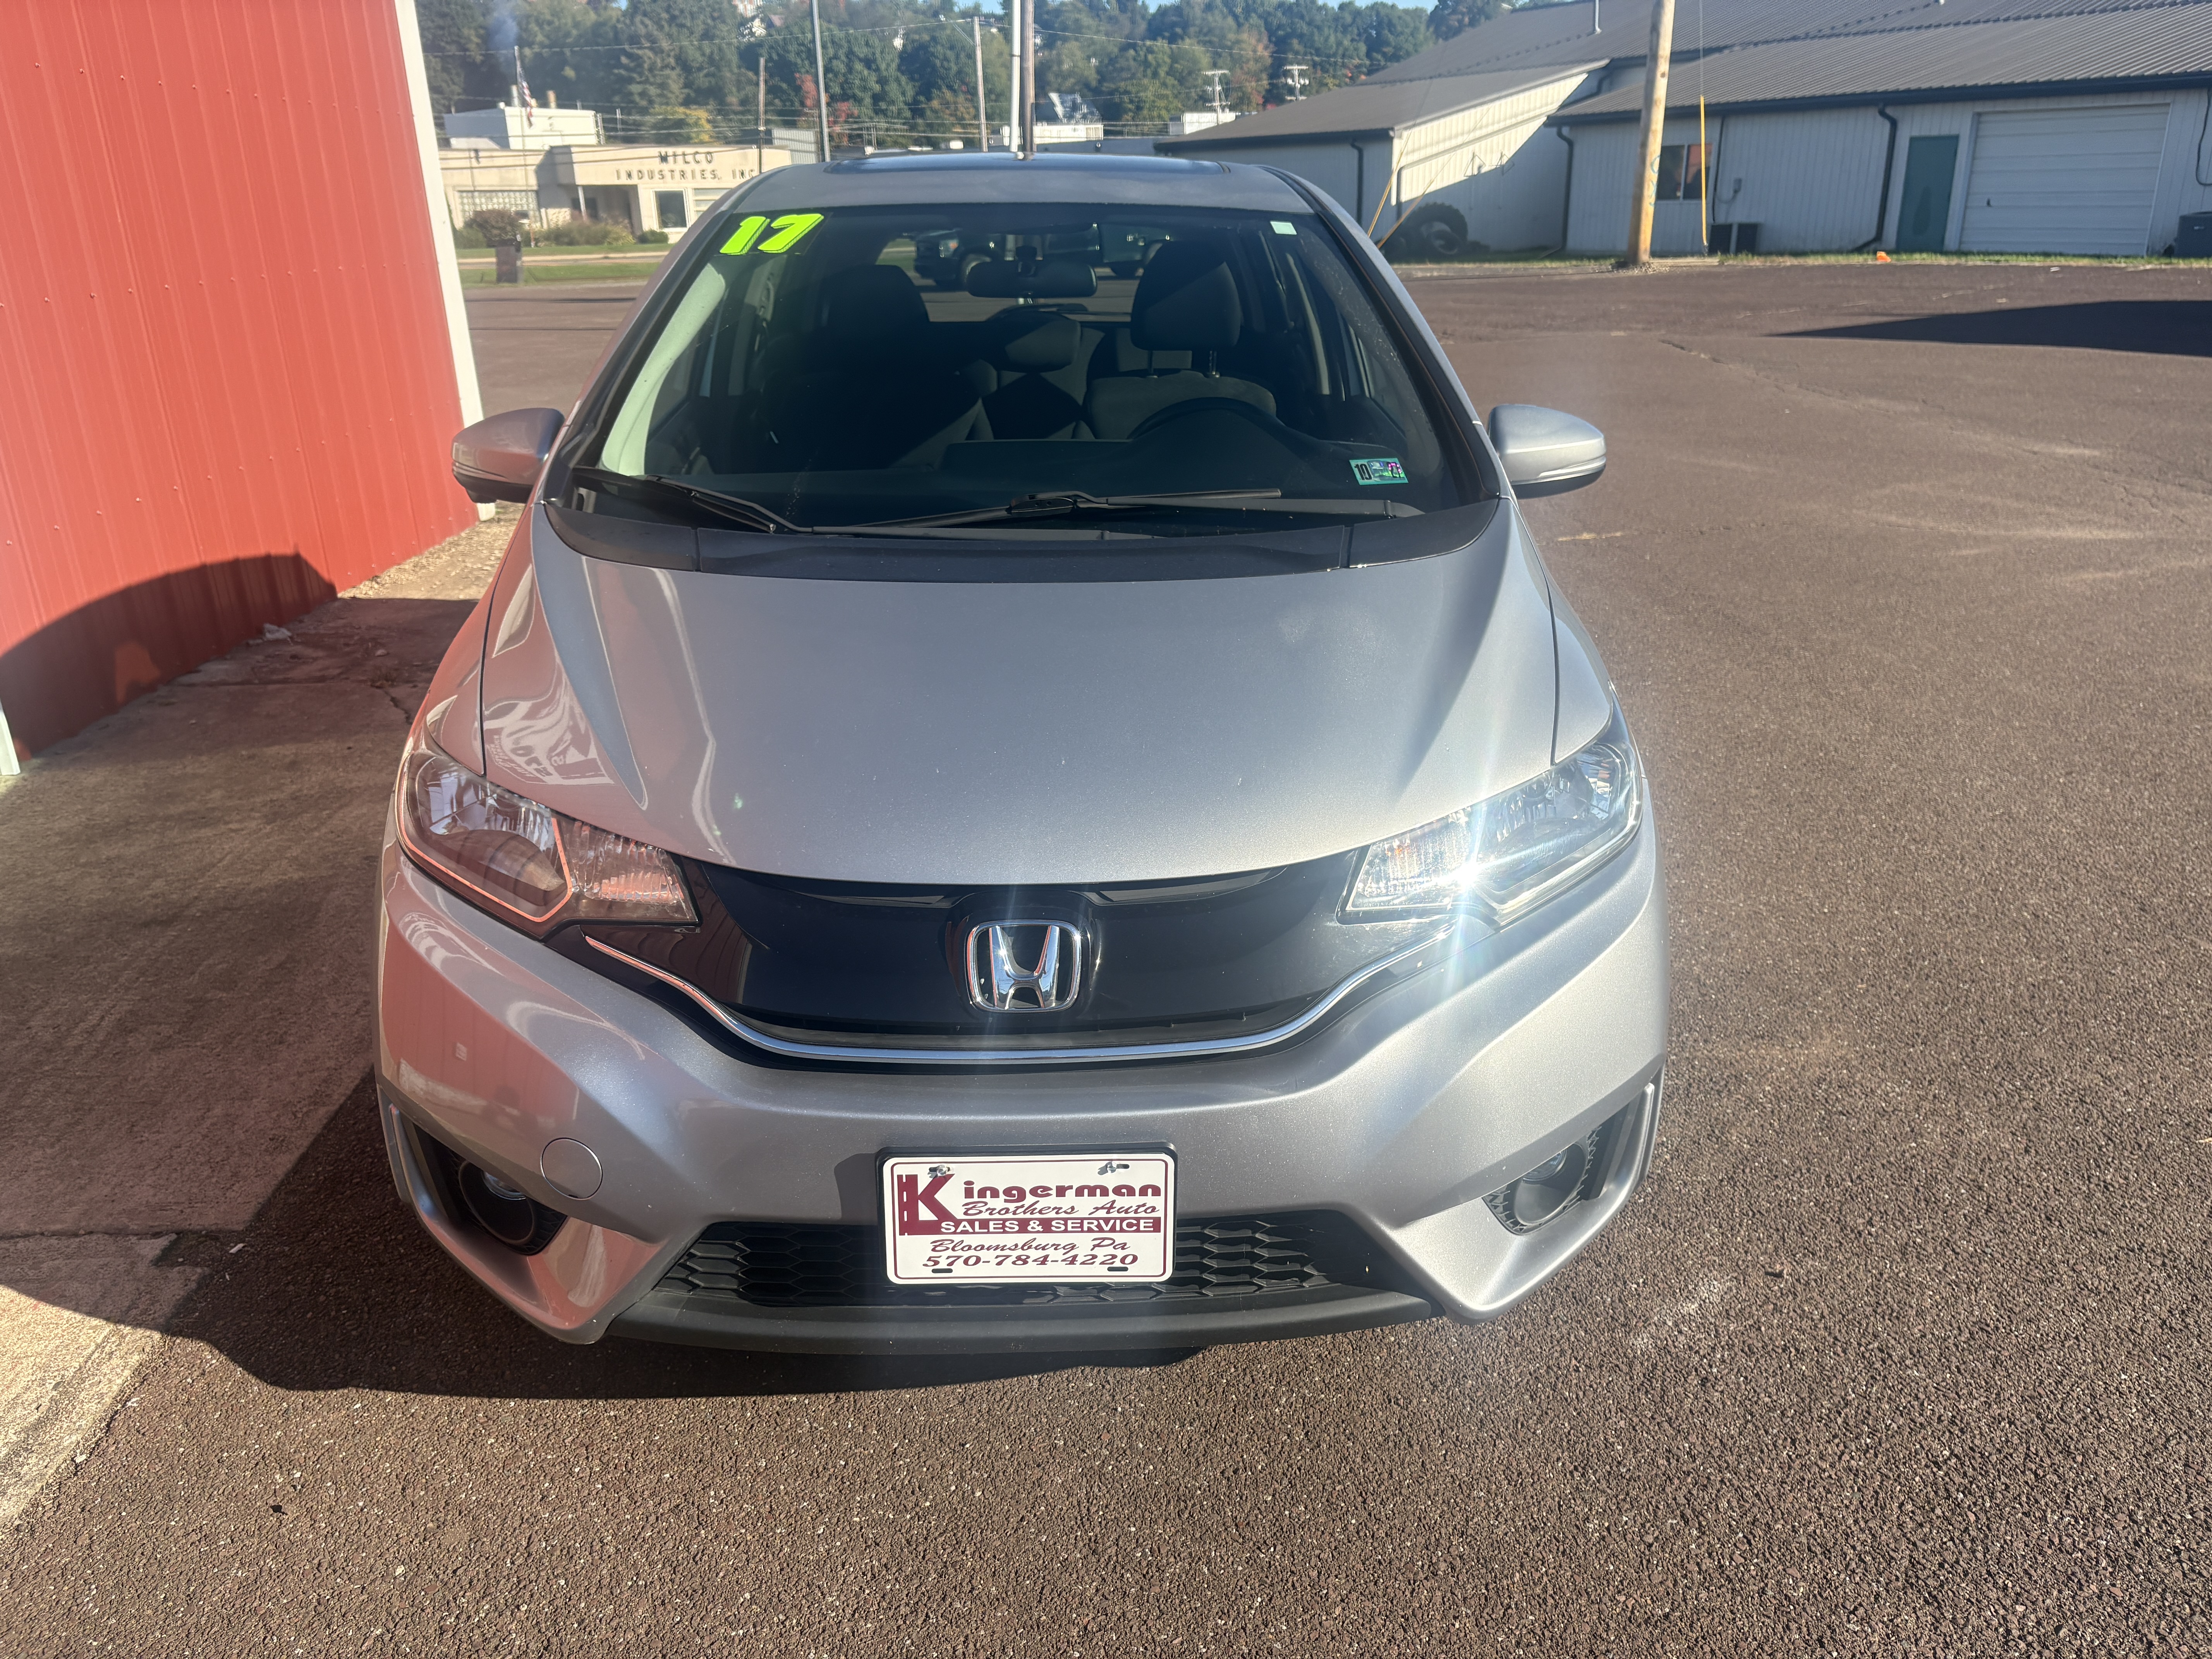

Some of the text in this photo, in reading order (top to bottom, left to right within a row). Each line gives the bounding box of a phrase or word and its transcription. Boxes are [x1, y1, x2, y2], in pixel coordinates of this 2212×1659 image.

[658, 151, 714, 164] MILCO
[719, 213, 824, 255] 17
[1354, 464, 1372, 481] 10
[897, 1173, 1161, 1236] Kingerman
[962, 1199, 1160, 1216] Brothers Auto
[941, 1219, 1154, 1233] SALES & SERVICE
[930, 1237, 1131, 1255] Bloomsburg Pa
[922, 1254, 1138, 1267] 570-784-4220
